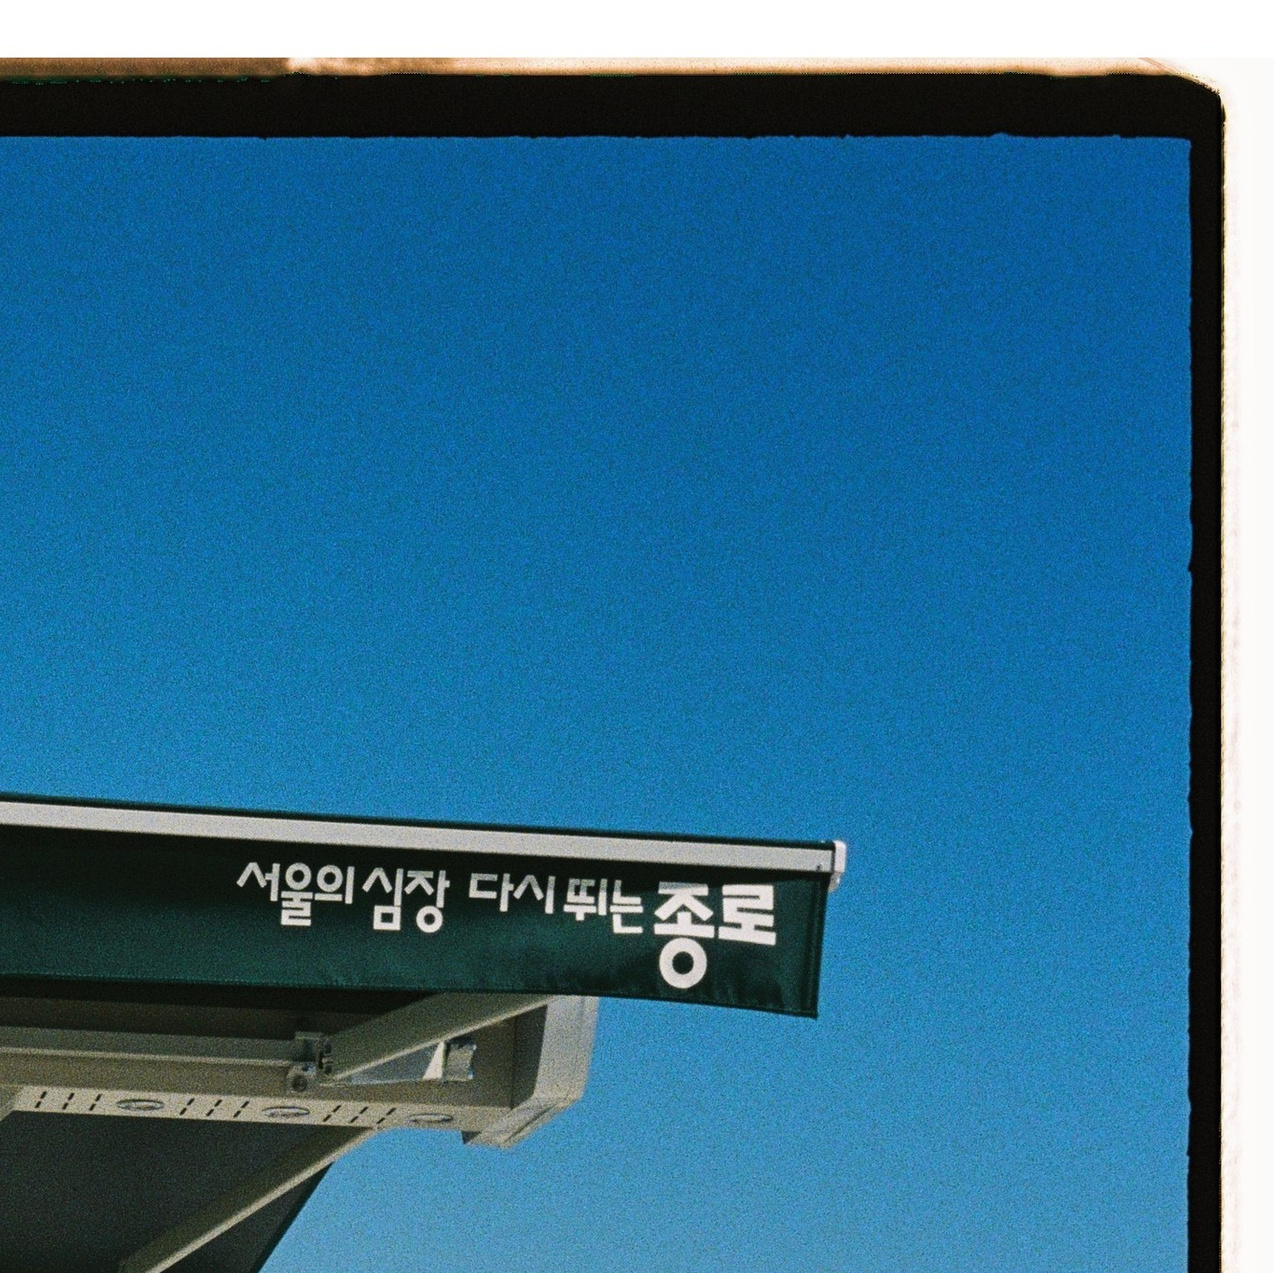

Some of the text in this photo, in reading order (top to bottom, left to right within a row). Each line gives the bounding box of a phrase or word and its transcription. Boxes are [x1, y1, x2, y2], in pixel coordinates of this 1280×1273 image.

[237, 863, 777, 989] 서울의 심장 다시 뛰는 종로
